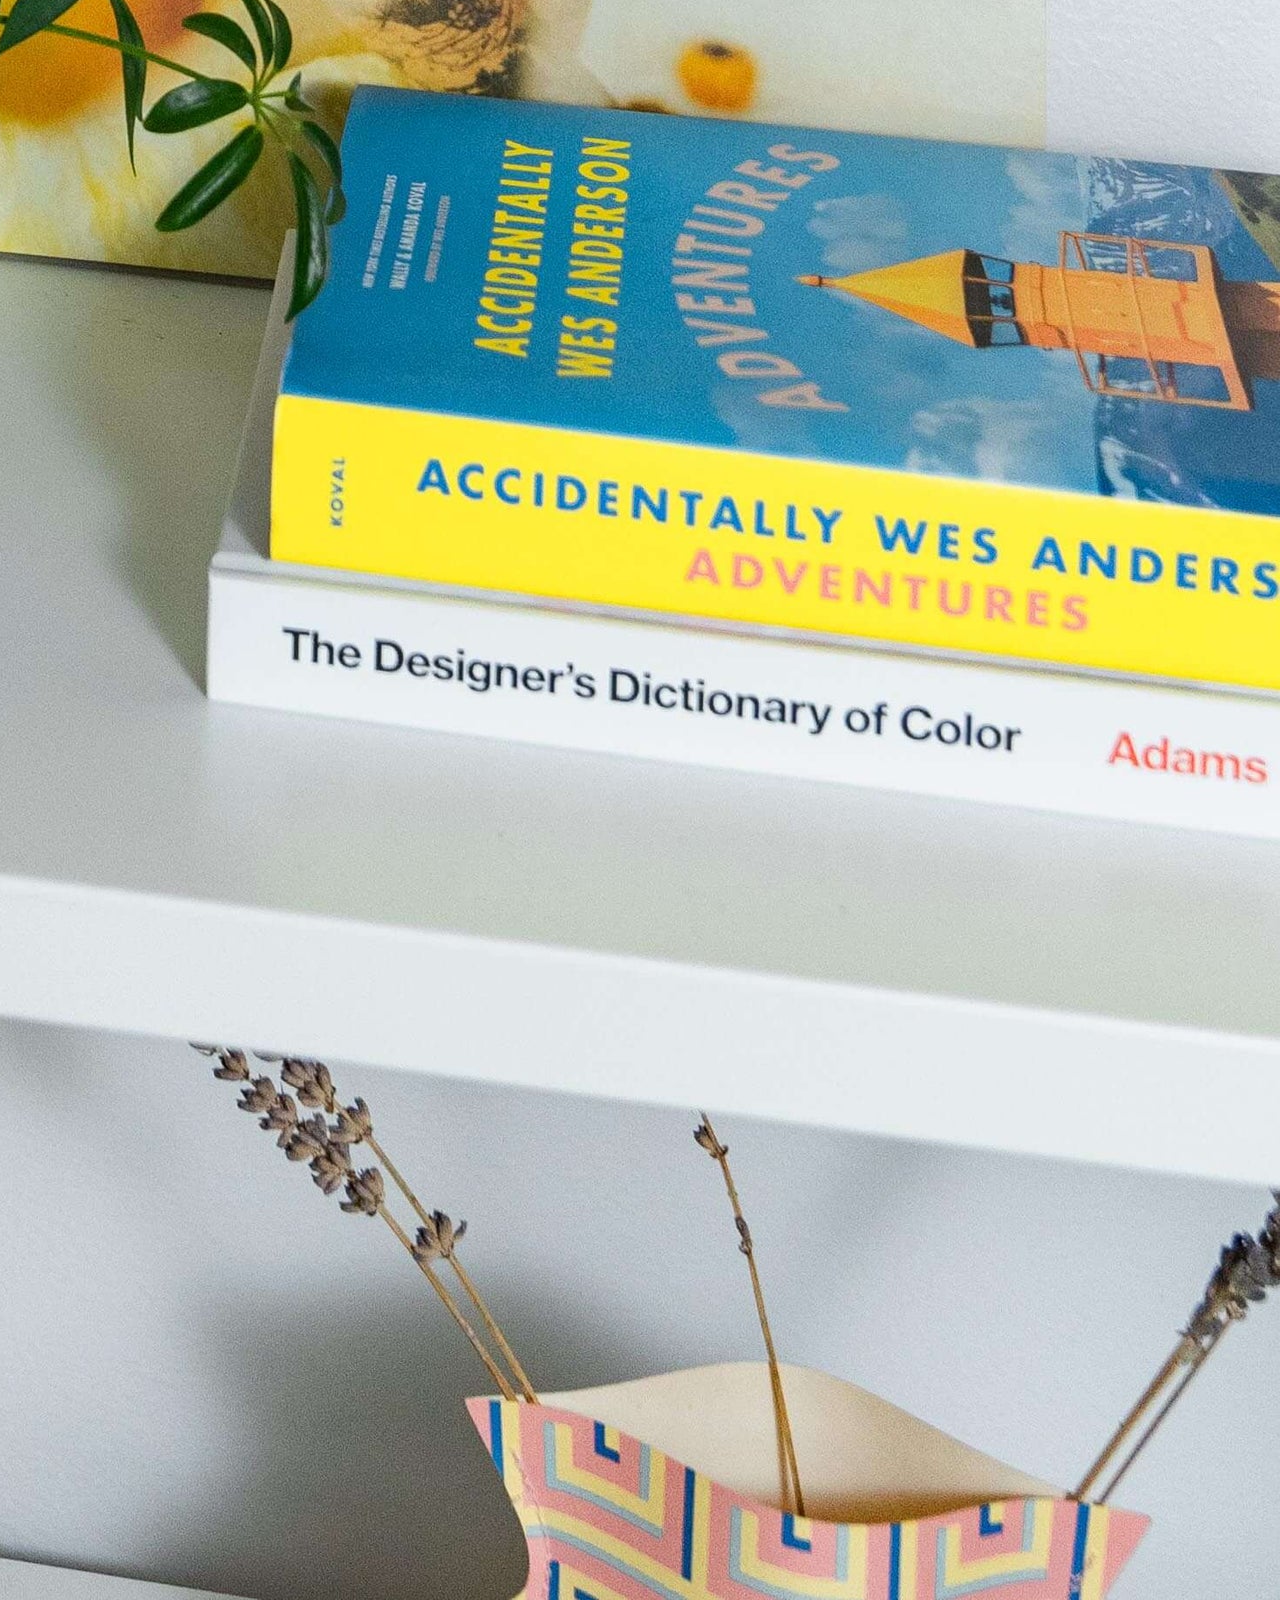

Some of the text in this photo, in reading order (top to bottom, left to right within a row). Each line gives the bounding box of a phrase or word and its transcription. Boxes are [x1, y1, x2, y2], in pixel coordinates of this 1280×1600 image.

[398, 213, 421, 251] AMANDA
[407, 181, 427, 212] KOVAL
[473, 138, 554, 358] ACCIDENTALLY
[389, 260, 410, 289] WALLY
[556, 136, 632, 378] WES ANDERSON
[670, 142, 851, 413] ADVENTURES
[330, 456, 346, 527] KOVAL
[416, 458, 1279, 601] ACCIDENTALLY WES ANDERS
[685, 548, 1090, 632] ADVENTURES
[282, 626, 1269, 786] The Designer’s Dictionary of Color Adams
